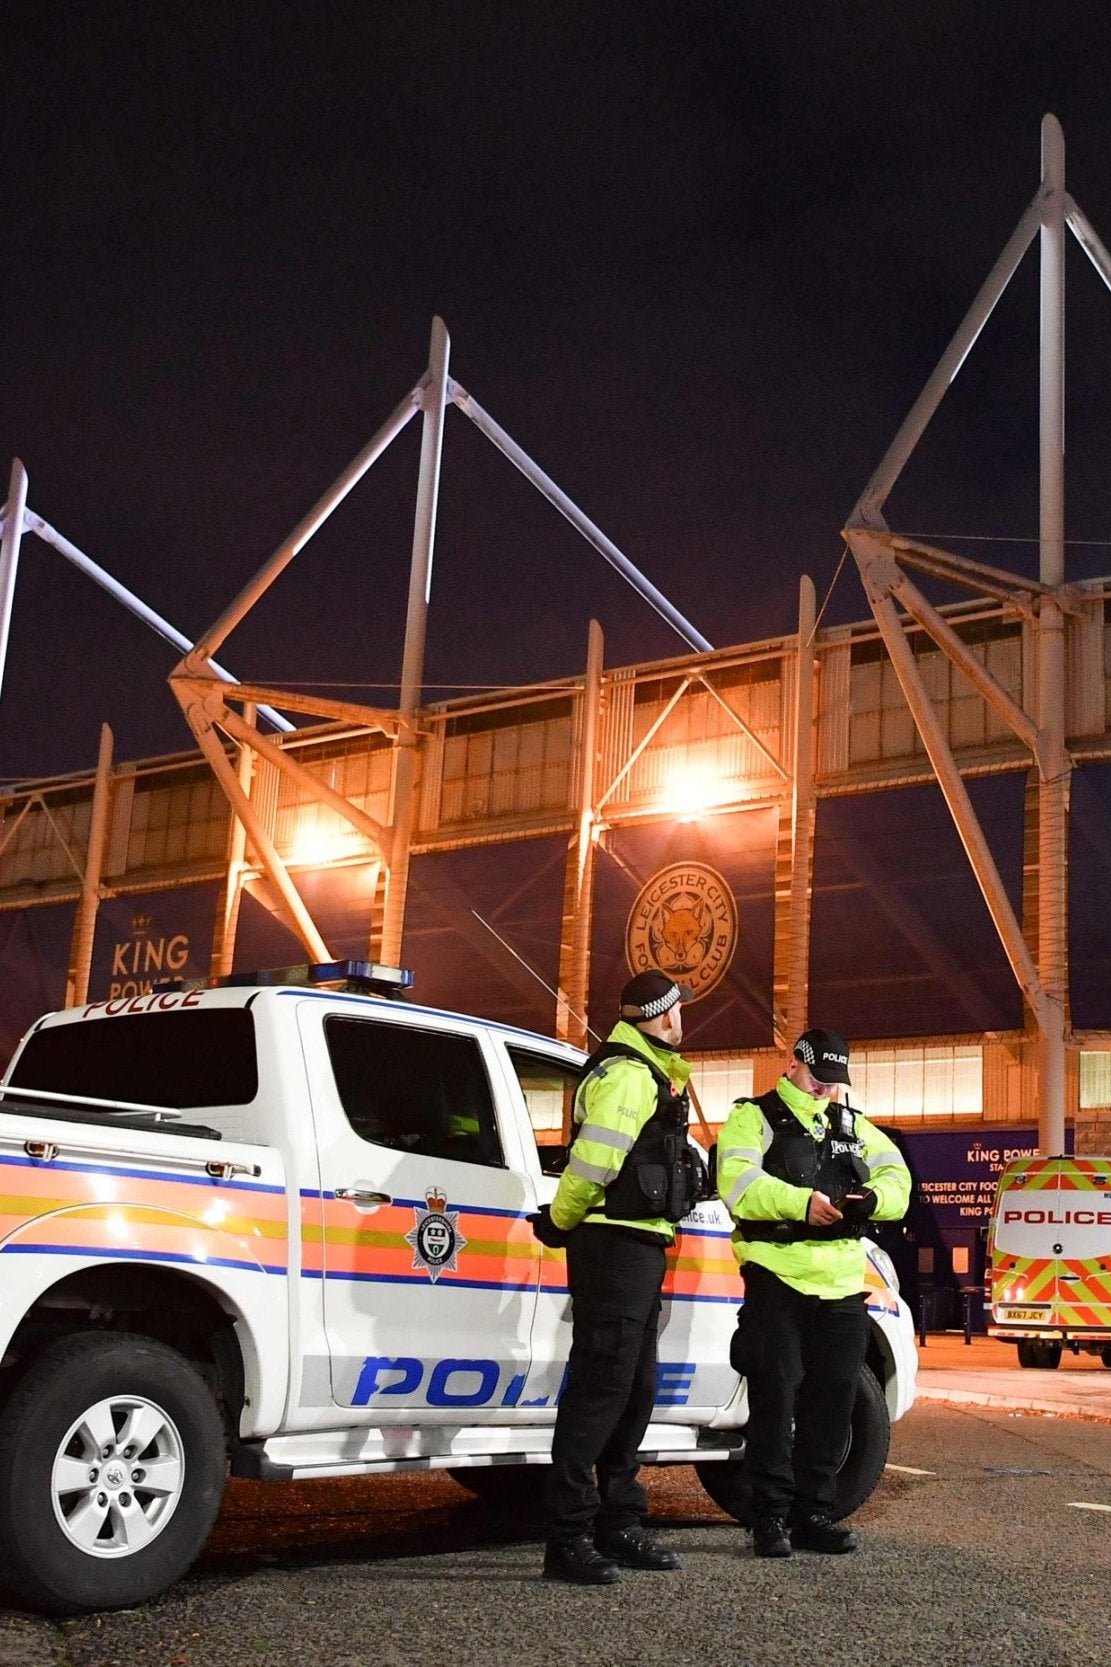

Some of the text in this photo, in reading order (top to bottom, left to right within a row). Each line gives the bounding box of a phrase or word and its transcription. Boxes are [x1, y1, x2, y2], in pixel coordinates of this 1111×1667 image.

[636, 873, 729, 931] LEICESTER CITY
[112, 935, 189, 976] KING
[700, 934, 727, 980] CLUB
[823, 1052, 848, 1065] POLICE
[967, 1149, 1040, 1162] KING POWE
[958, 1182, 977, 1191] CITY
[931, 1195, 975, 1204] WELCOME
[977, 1195, 991, 1203] ALL
[960, 1206, 982, 1216] KING
